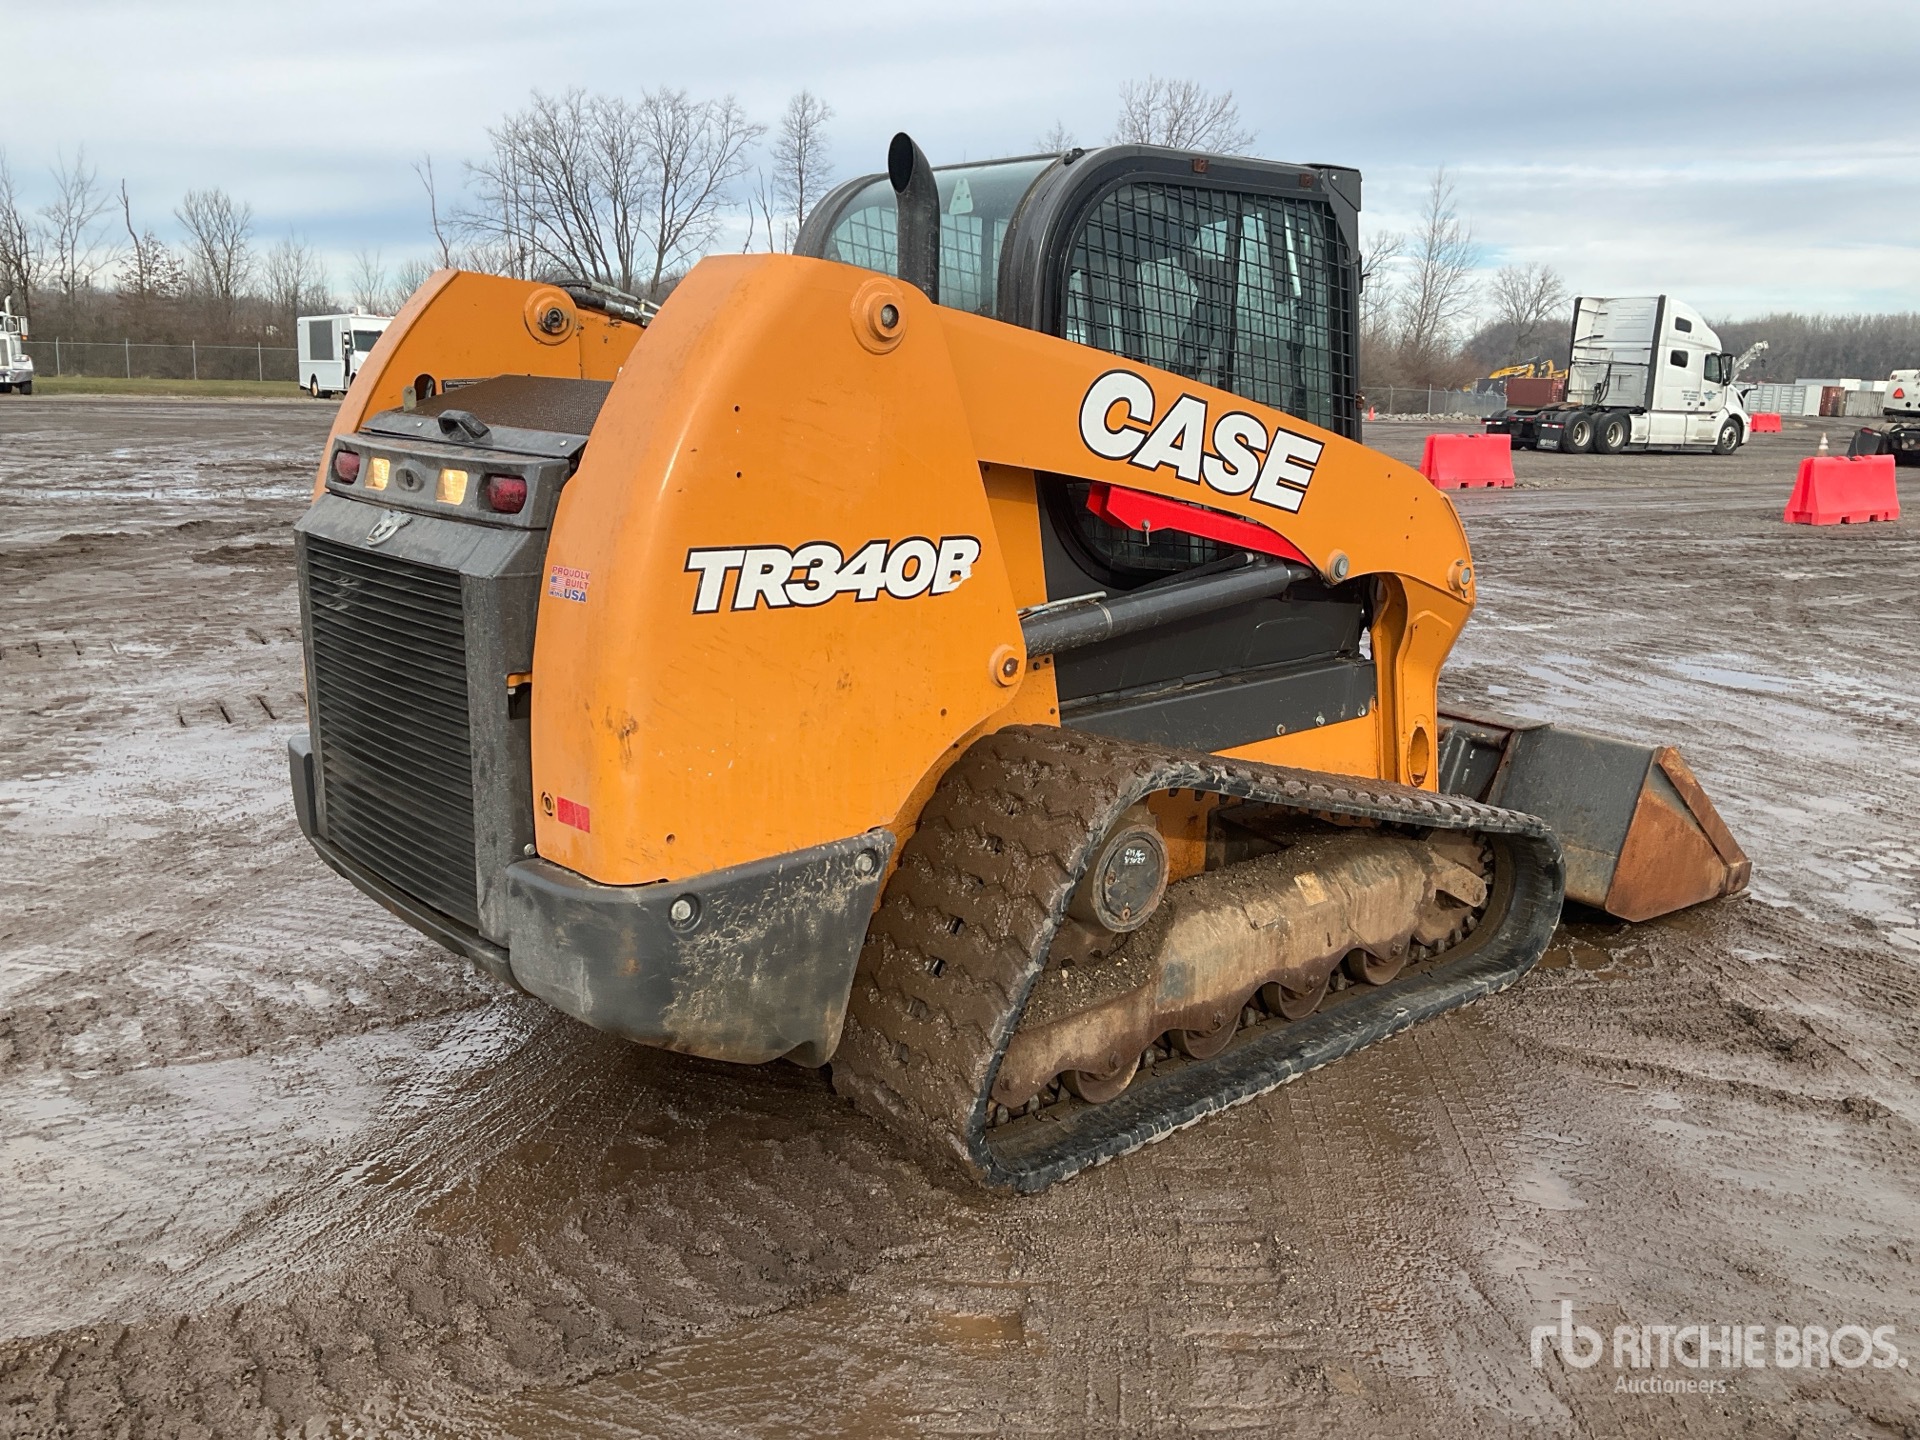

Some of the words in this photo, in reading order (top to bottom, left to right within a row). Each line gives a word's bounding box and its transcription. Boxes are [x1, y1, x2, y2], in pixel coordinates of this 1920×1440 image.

[1079, 369, 1325, 514] CASE
[552, 566, 591, 580] PROUDLY
[684, 536, 981, 614] TR340B
[565, 578, 589, 590] BUILT
[564, 588, 587, 602] USA
